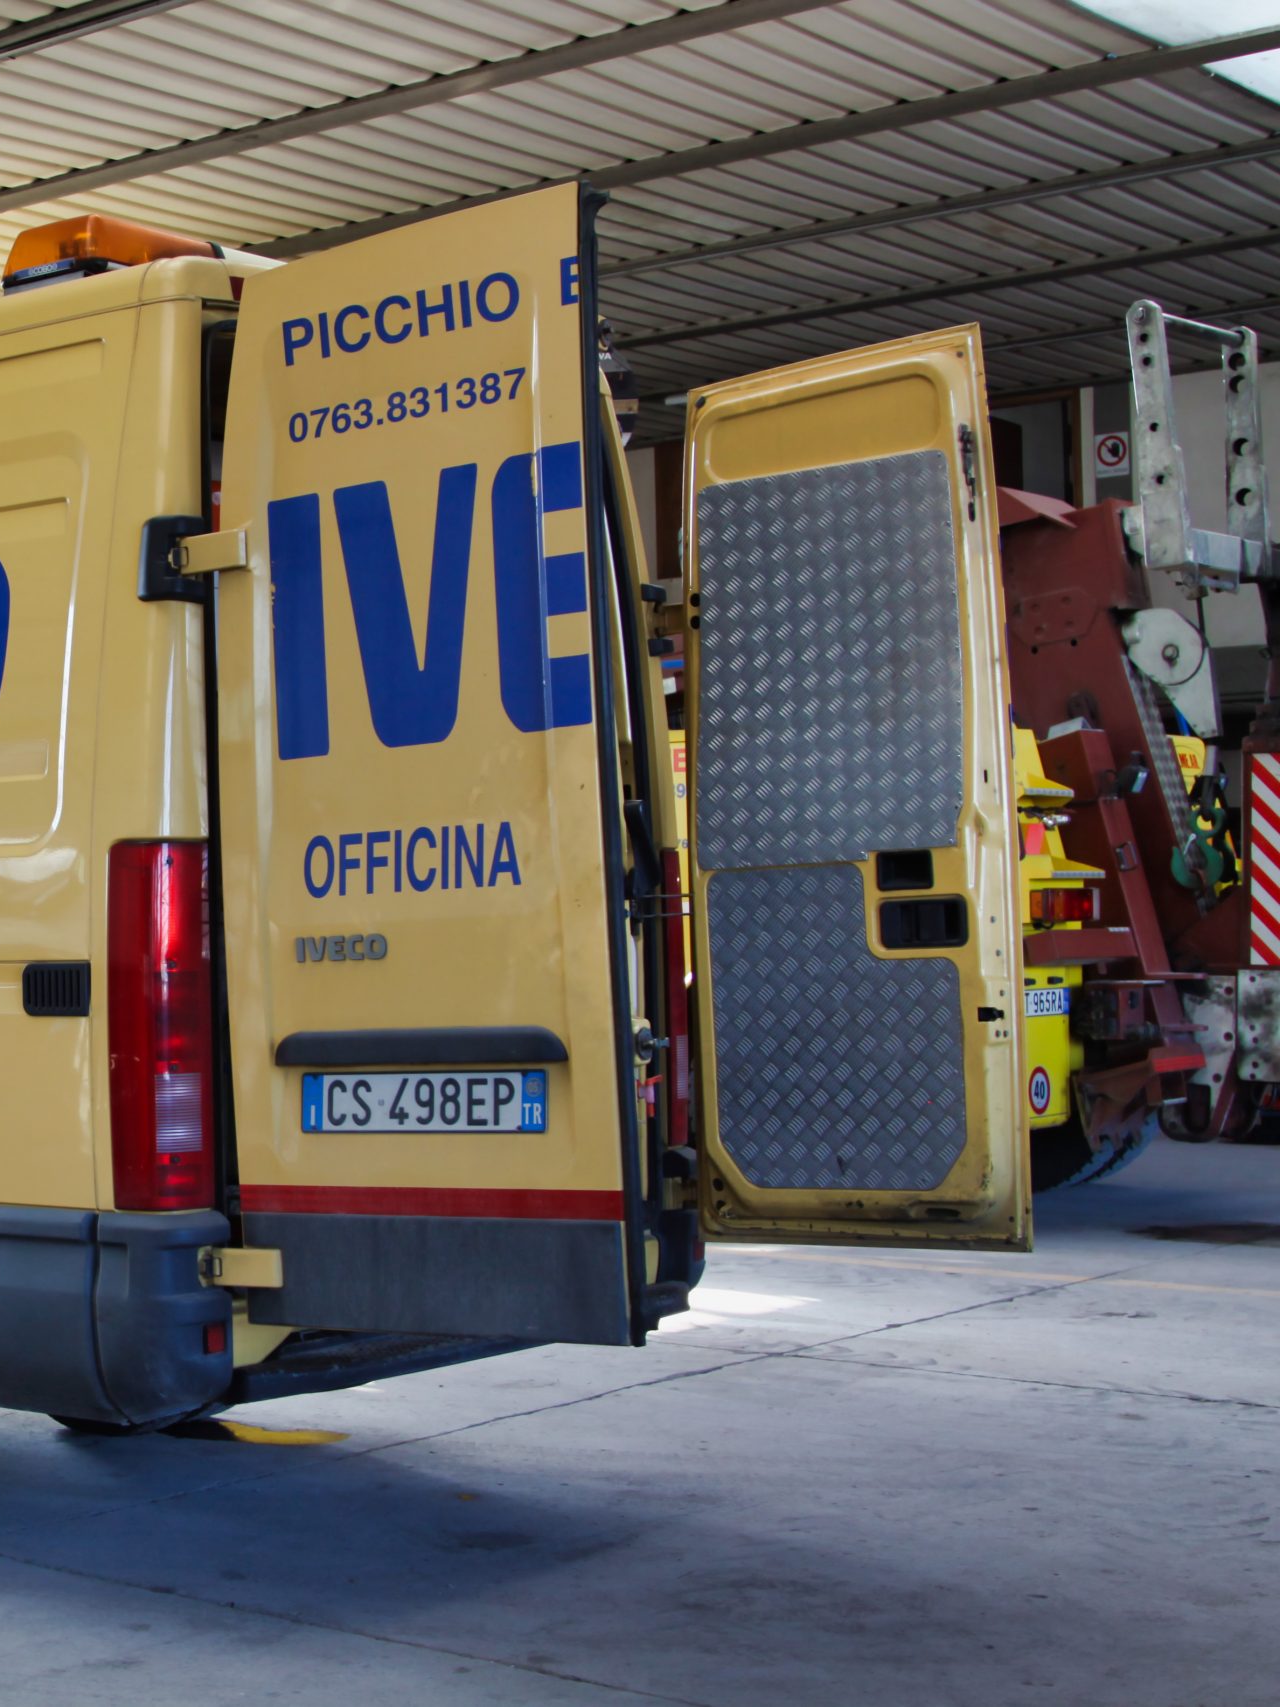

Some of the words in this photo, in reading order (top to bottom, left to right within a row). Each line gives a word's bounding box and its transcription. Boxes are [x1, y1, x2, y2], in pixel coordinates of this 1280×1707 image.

[282, 272, 520, 367] PICCHIO
[288, 367, 527, 443] 0763.831387
[303, 821, 522, 899] OFFICINA
[295, 933, 388, 963] IVECO
[1033, 991, 1062, 1013] 965RA
[327, 1079, 372, 1126] CS
[389, 1078, 516, 1126] 498EP
[1033, 1080, 1046, 1100] 40
[523, 1102, 542, 1125] TR
